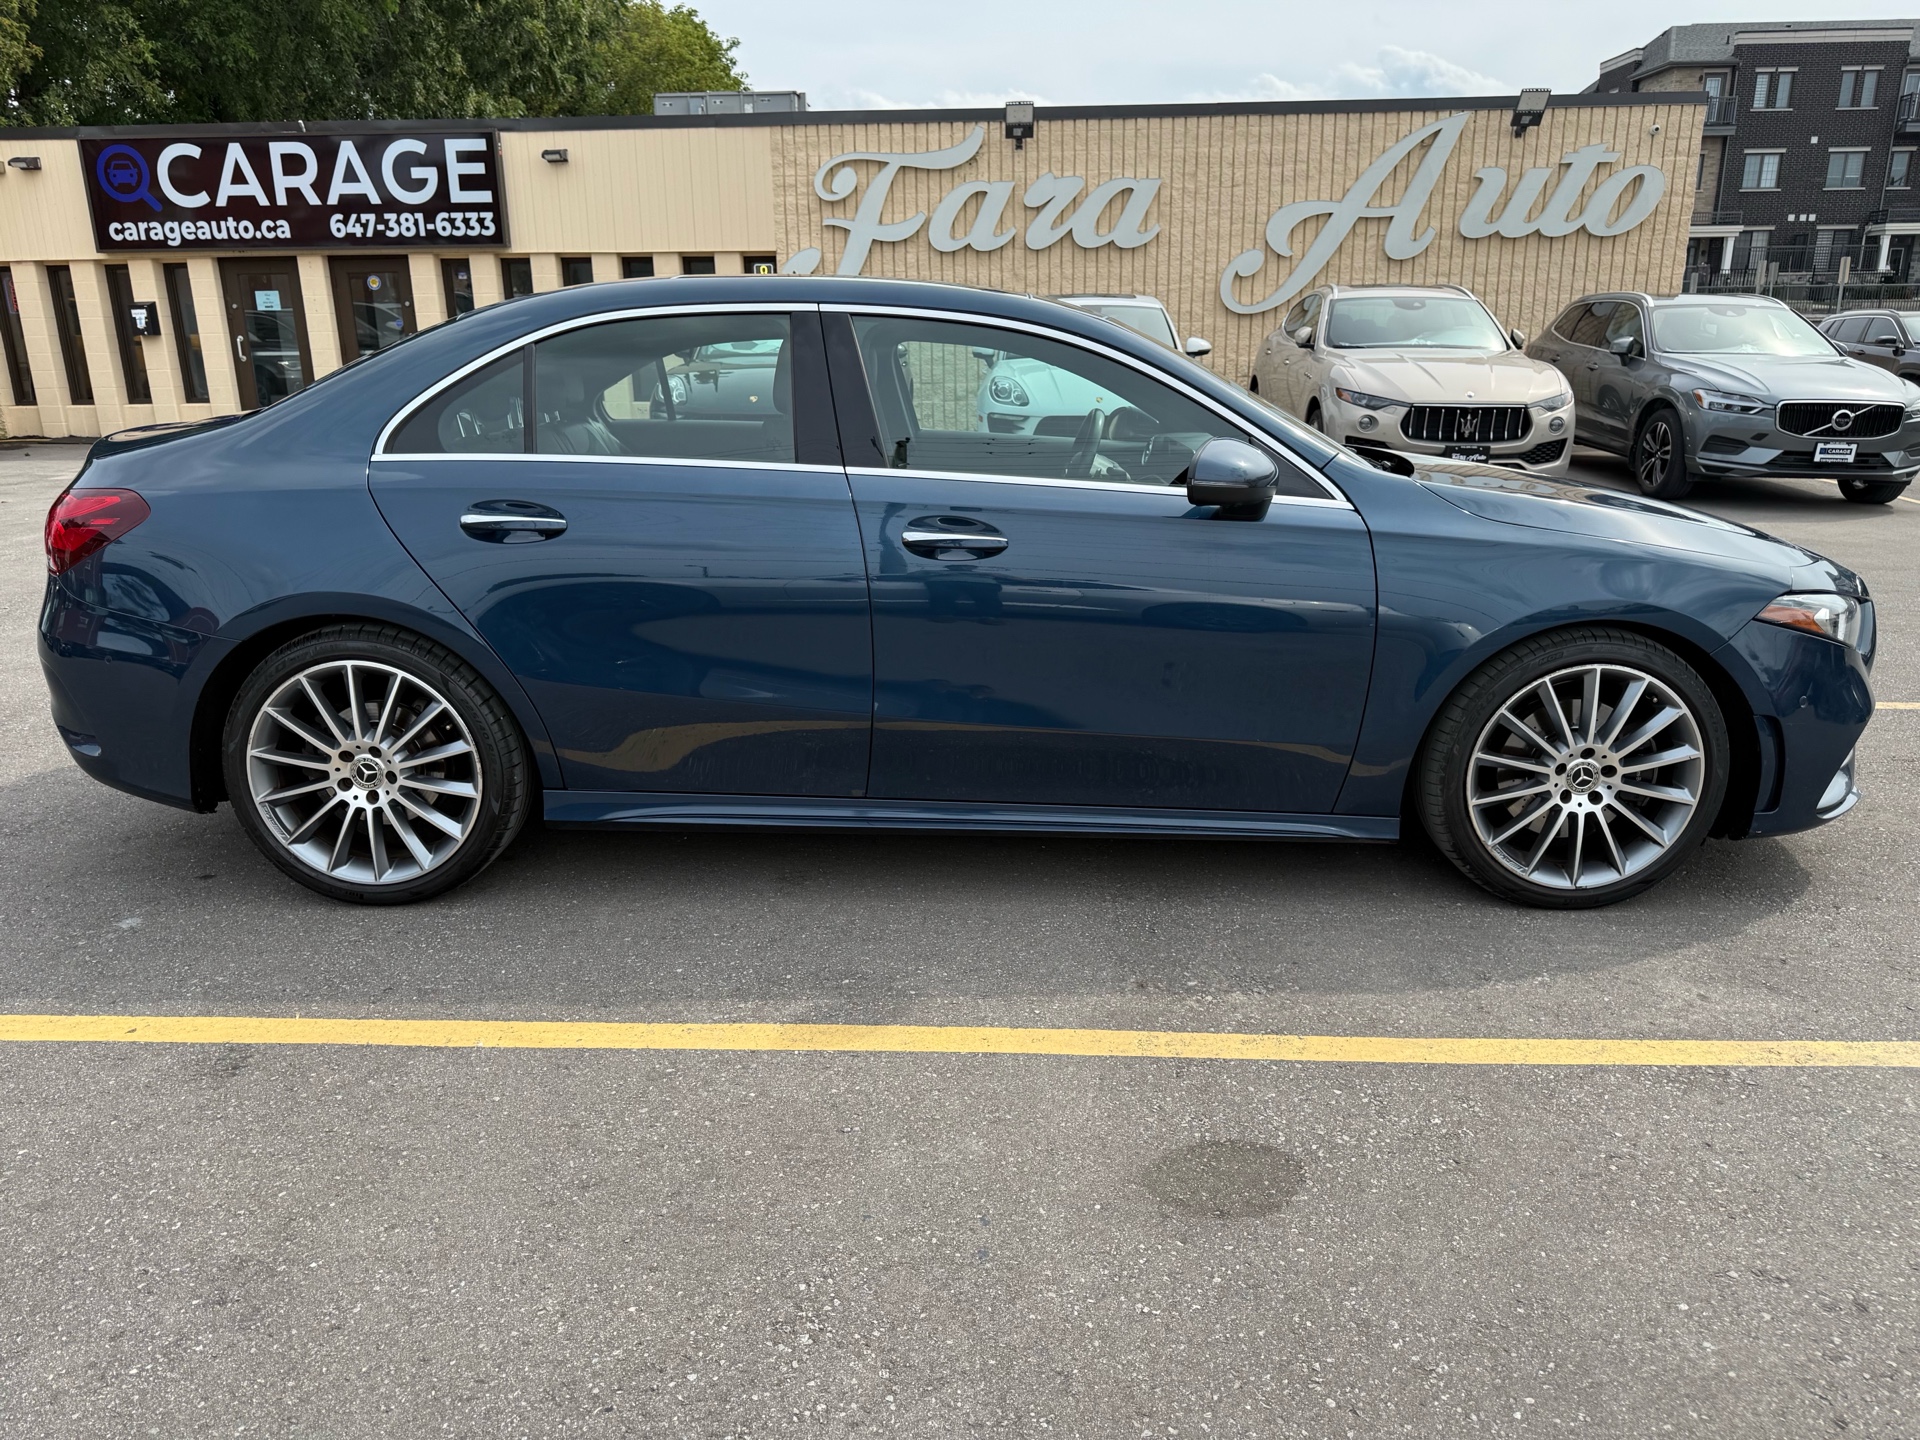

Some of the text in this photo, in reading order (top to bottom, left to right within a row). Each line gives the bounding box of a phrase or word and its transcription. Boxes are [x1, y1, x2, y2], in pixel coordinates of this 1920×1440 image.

[157, 138, 494, 208] CARAGE
[108, 211, 497, 247] carageauto.ca 647-381-6333
[783, 112, 1666, 315] Fara Auto
